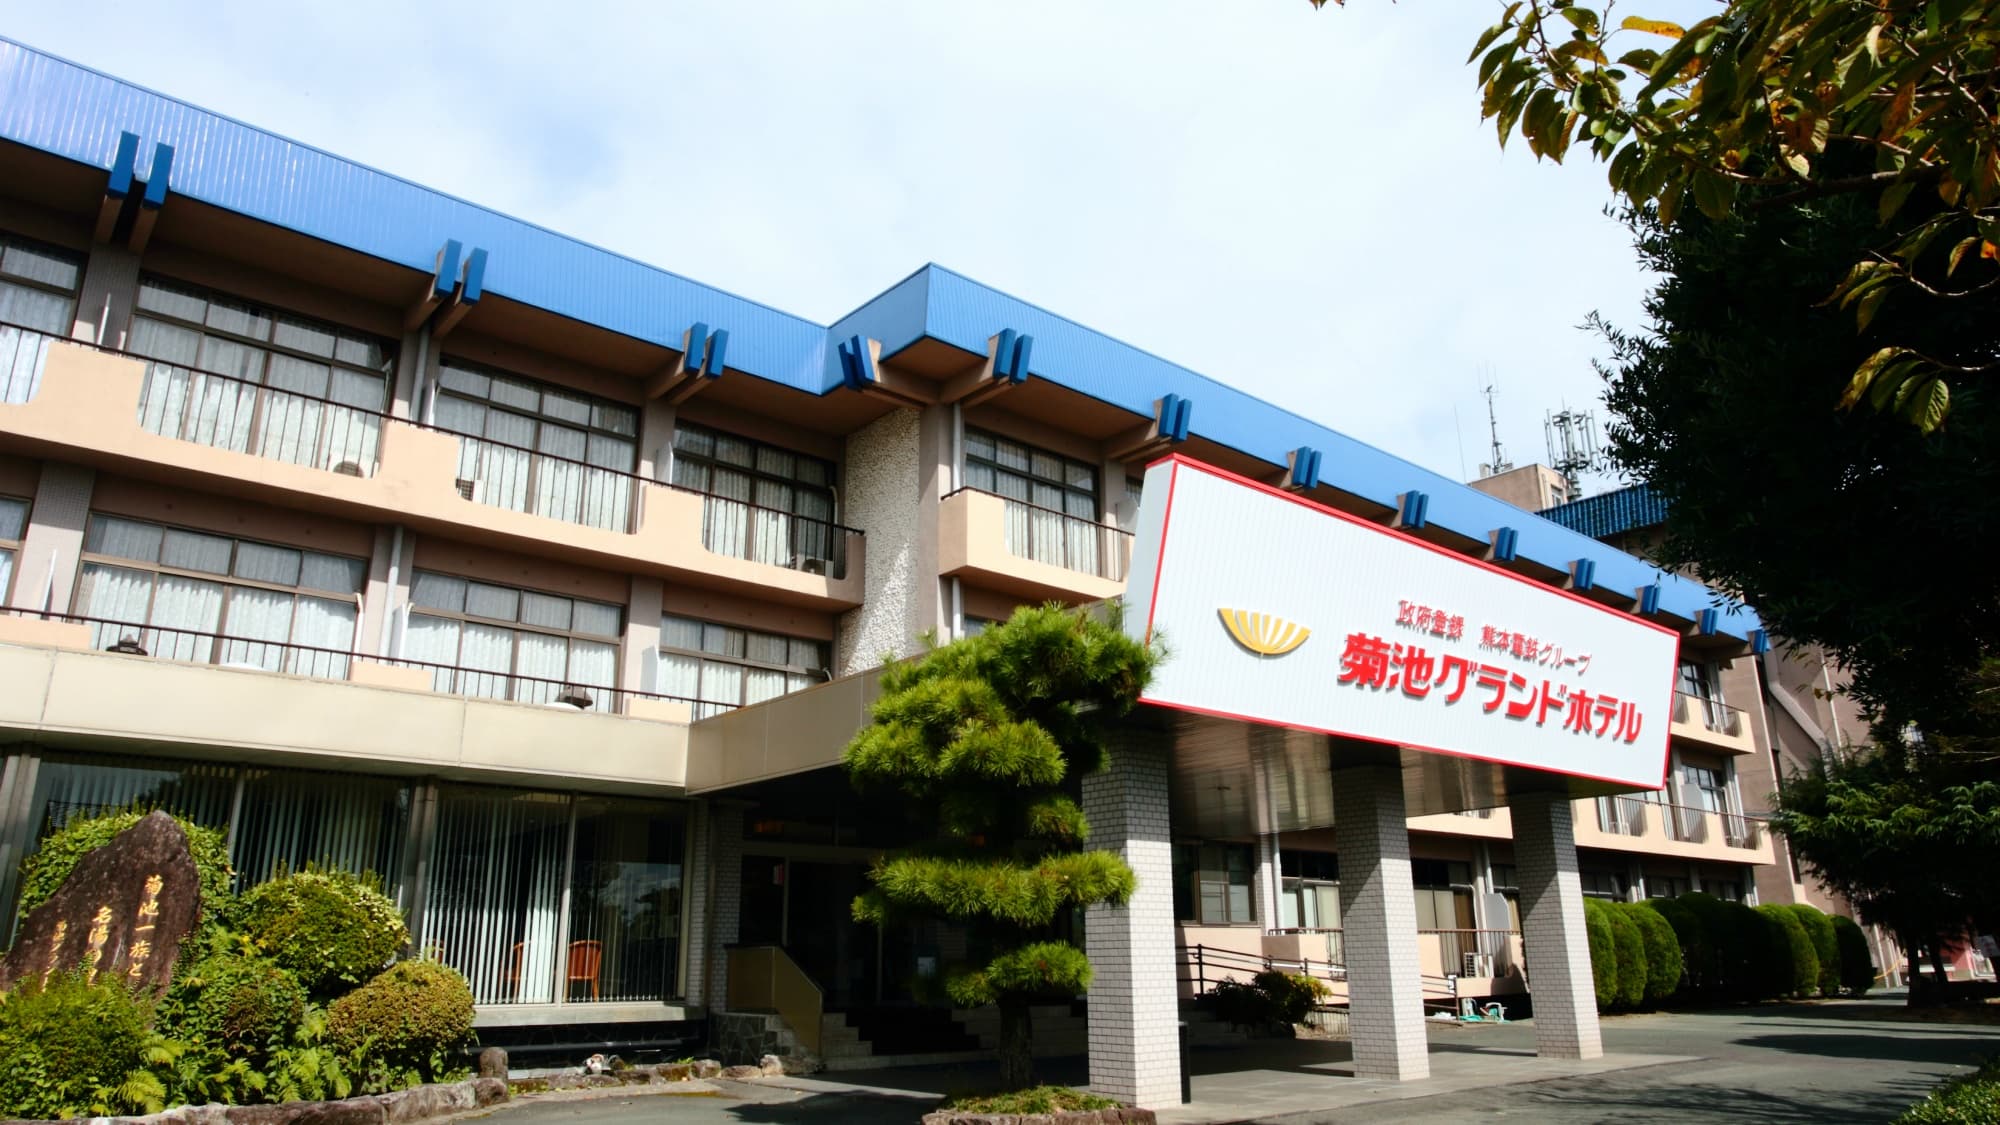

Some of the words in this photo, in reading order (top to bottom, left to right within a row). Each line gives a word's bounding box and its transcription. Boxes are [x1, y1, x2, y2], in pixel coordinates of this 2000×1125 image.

[1338, 632, 1643, 742] 菊池グランドホテル
[1398, 600, 1465, 639] 政府登録
[1480, 623, 1593, 673] 熊本電鉄グループ
[129, 874, 164, 977] 菊池一族と
